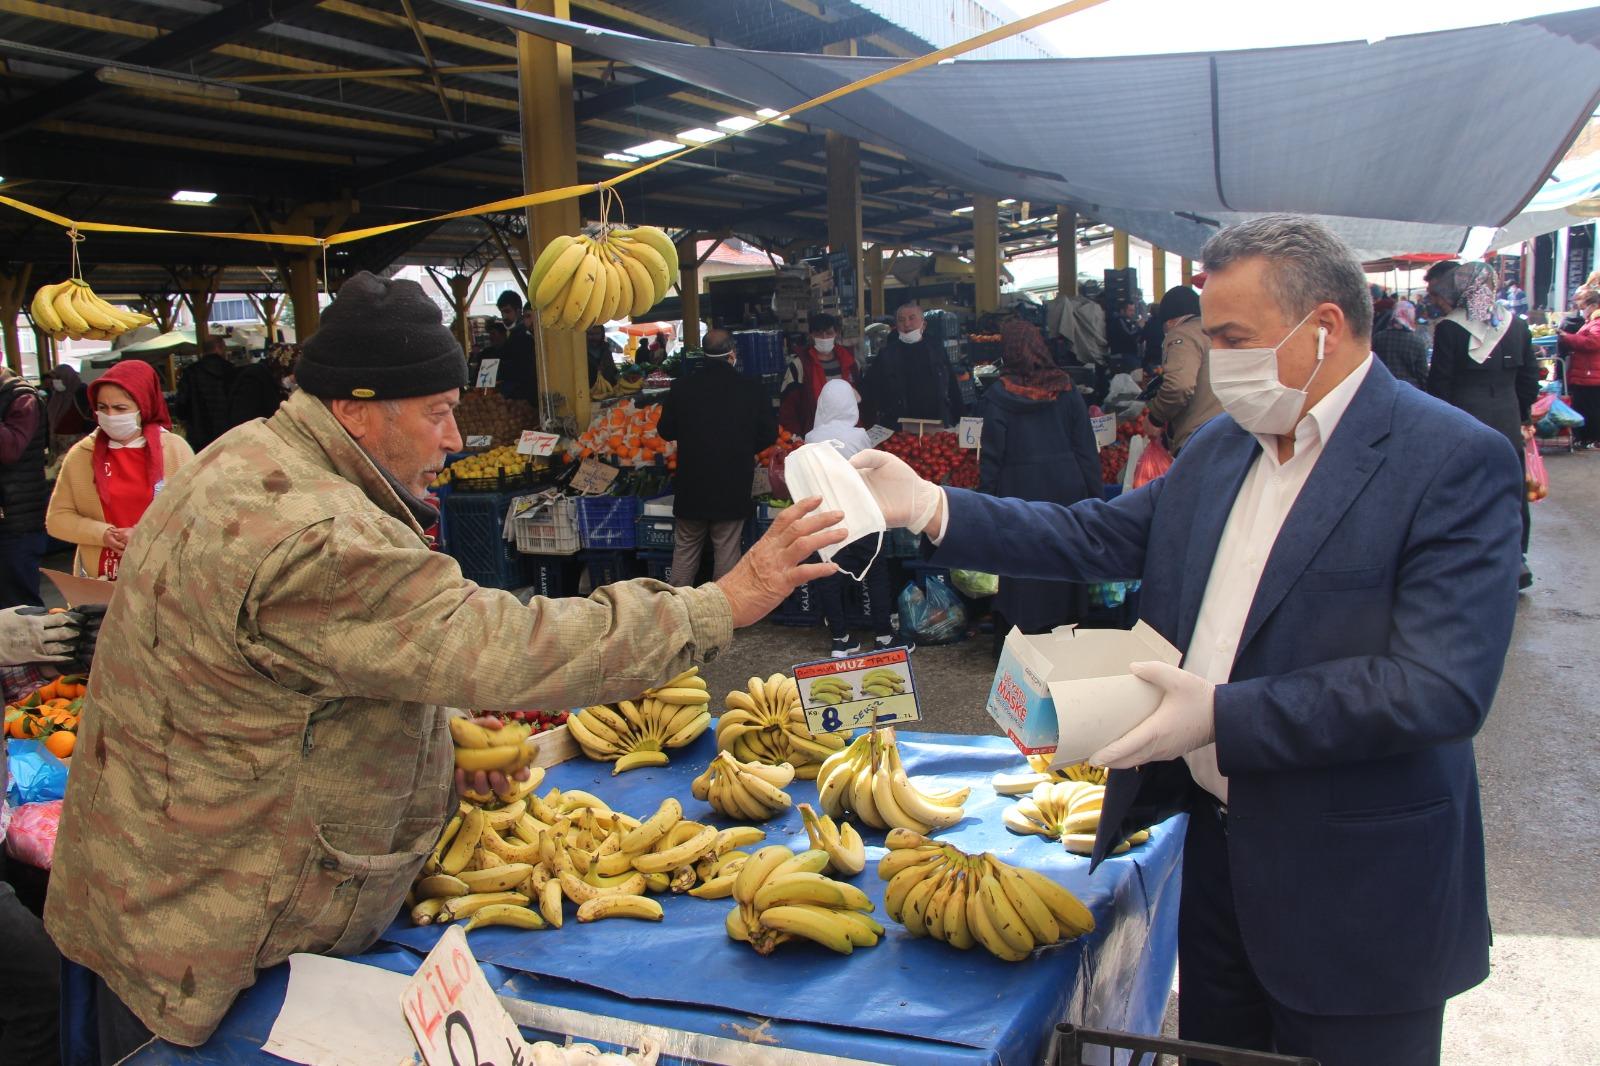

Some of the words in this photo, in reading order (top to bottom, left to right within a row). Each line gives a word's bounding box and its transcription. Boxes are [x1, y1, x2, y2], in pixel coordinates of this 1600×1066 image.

[966, 426, 976, 445] 6
[835, 658, 866, 672] MUZ
[997, 680, 1027, 722] MASKE
[821, 706, 843, 732] 8
